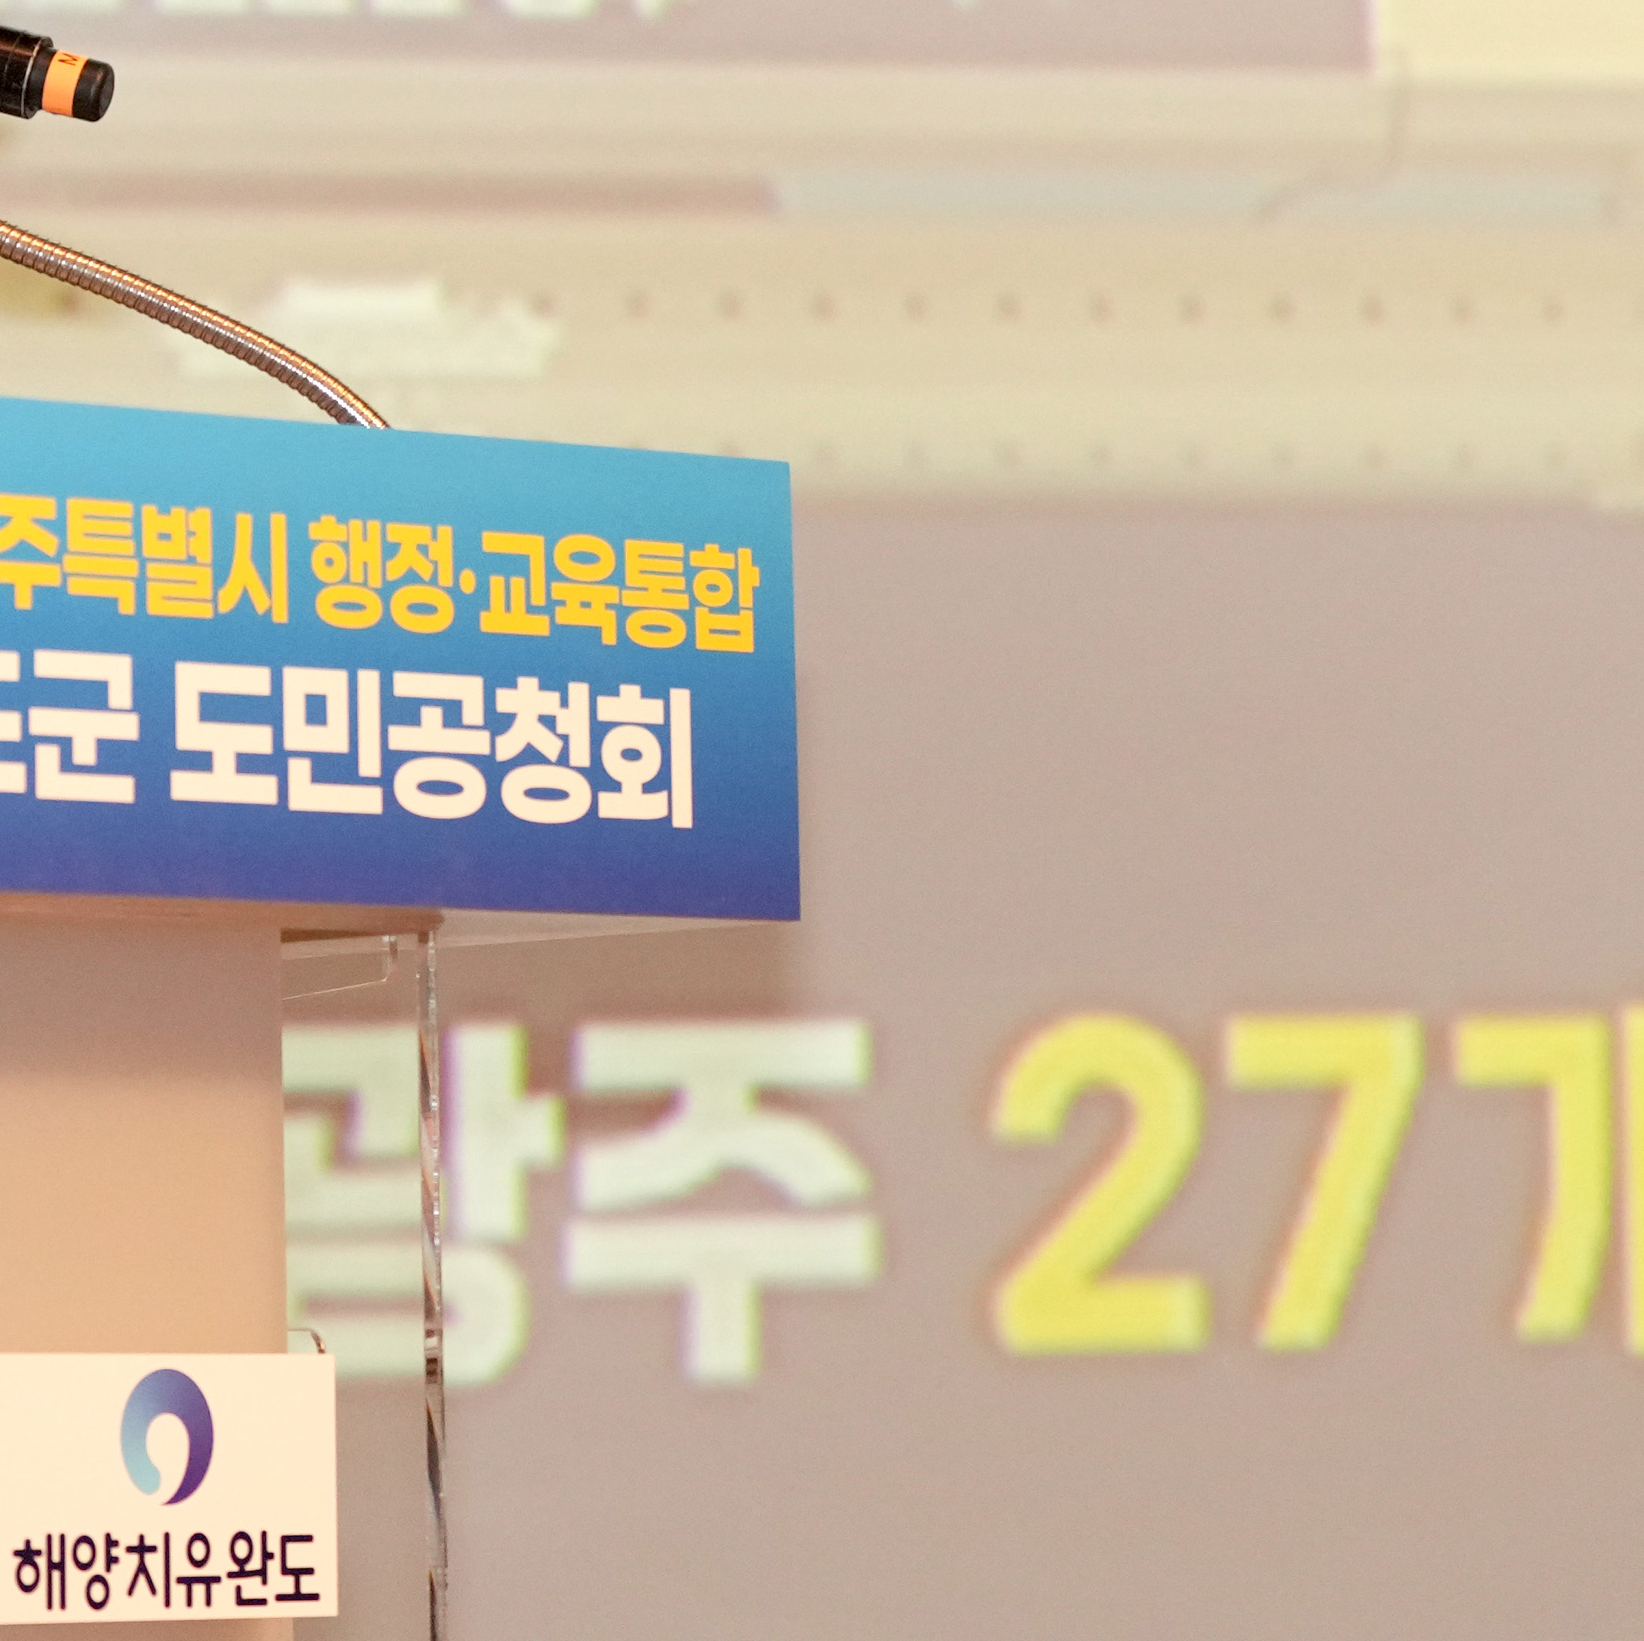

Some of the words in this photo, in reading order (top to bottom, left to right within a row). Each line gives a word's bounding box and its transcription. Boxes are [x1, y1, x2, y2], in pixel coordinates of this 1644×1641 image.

[308, 514, 762, 654] 행정·교육통합
[168, 659, 695, 830] 도민공청회
[12, 1530, 321, 1611] 해양치유완도
